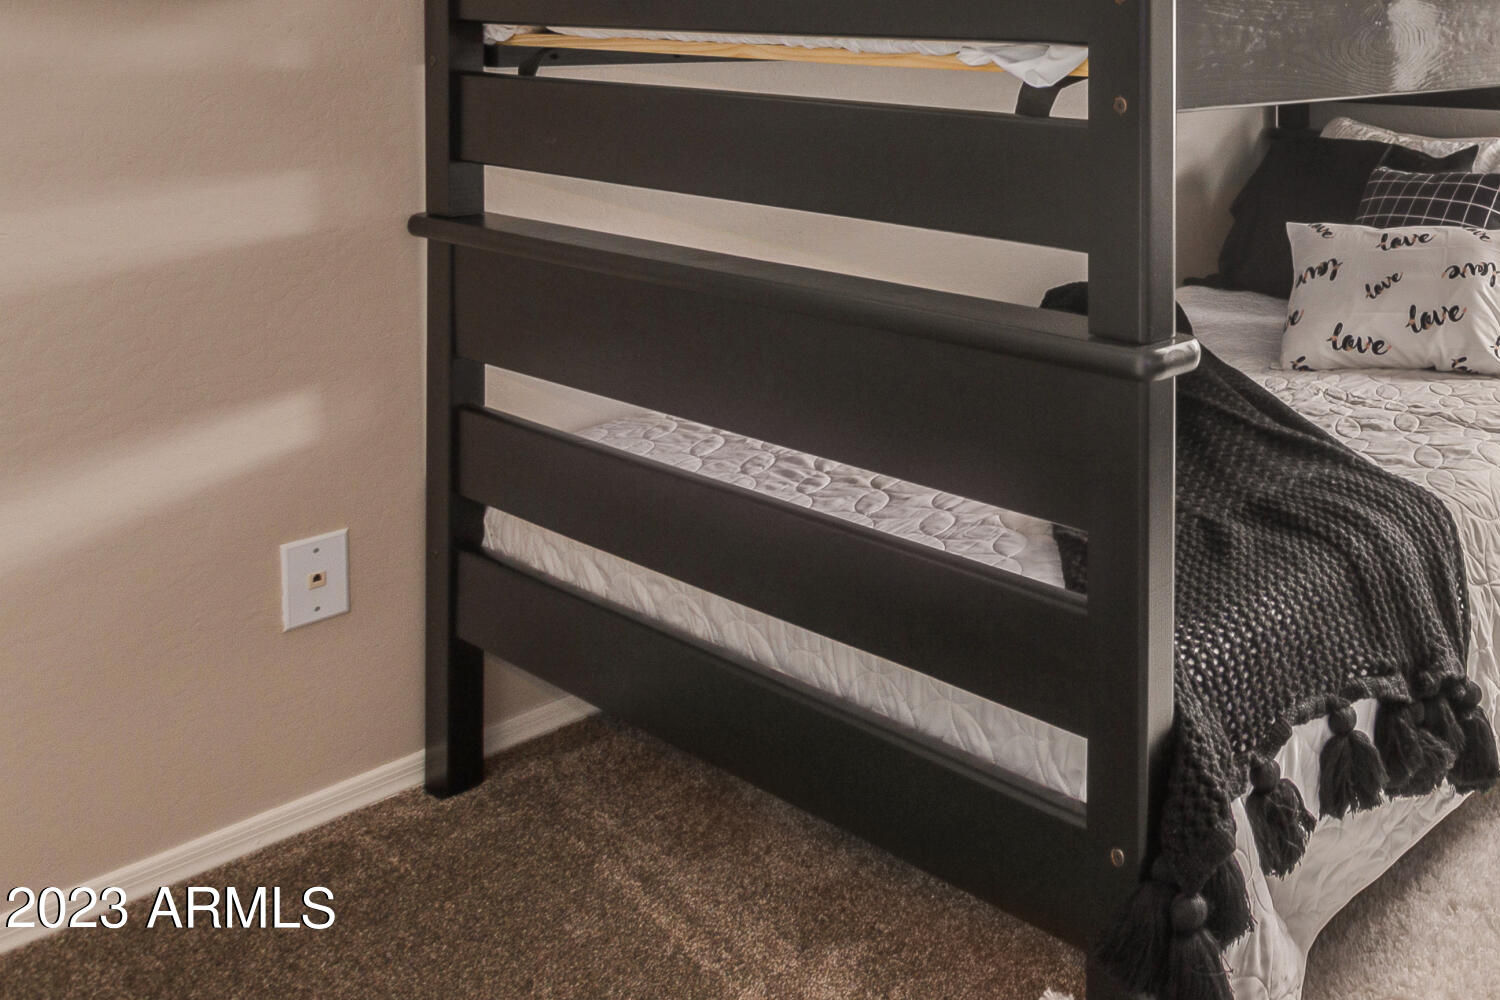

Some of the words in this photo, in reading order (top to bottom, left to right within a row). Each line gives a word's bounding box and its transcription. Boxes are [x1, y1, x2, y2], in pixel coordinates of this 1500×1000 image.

[1378, 232, 1437, 251] love
[1366, 271, 1404, 300] love
[1442, 260, 1500, 288] love
[1406, 304, 1468, 334] love
[1326, 322, 1392, 356] love
